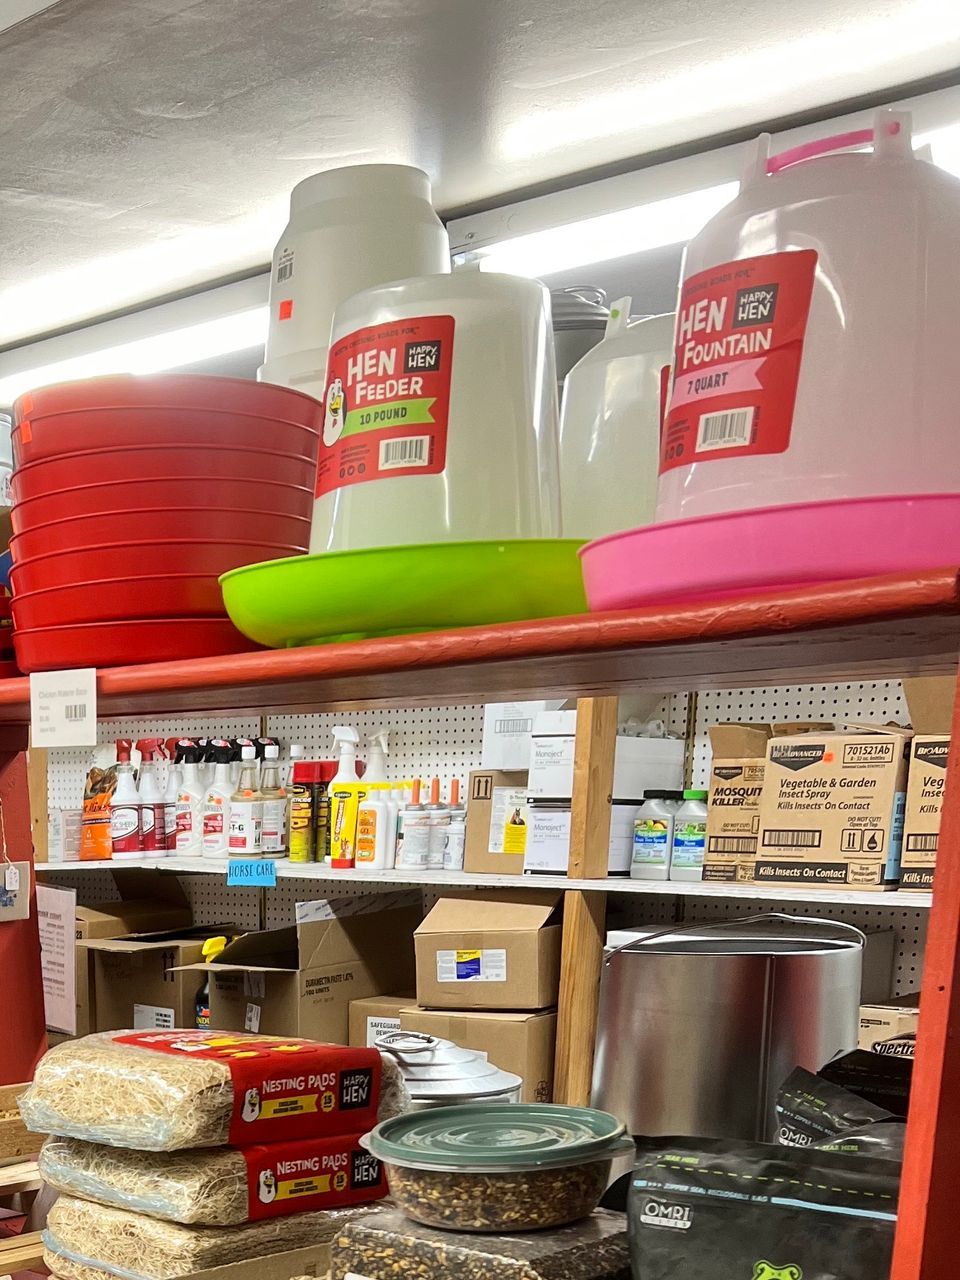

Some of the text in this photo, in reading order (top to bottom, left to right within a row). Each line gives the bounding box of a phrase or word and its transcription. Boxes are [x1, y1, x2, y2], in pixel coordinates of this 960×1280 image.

[740, 291, 773, 305] HAPPY
[738, 303, 770, 320] HEN
[678, 297, 727, 345] HEN
[409, 346, 437, 356] HAPPY
[683, 328, 772, 369] FOUNTAIN
[347, 348, 396, 386] HEN
[408, 354, 436, 368] HEN
[356, 376, 424, 404] FEEDER
[688, 372, 728, 394] 7 QUART
[359, 407, 407, 425] 10 POUND
[847, 746, 890, 755] 701521Ab
[780, 778, 877, 789] Vegetable & Garden
[712, 798, 745, 807] KILLER
[778, 790, 831, 800] Insect Spray
[777, 802, 794, 810] Kills
[824, 802, 836, 810] On
[837, 802, 870, 810] Contact
[920, 805, 938, 814] Kills
[229, 862, 274, 878] HORSE CARE
[759, 867, 774, 876] Kills
[775, 867, 801, 877] Insects
[803, 868, 814, 877] On
[816, 868, 846, 878] Contact
[903, 873, 920, 882] Kills
[262, 1073, 336, 1095] NESTING PADS
[343, 1075, 369, 1089] HAPPY
[343, 1084, 368, 1104] HEN
[779, 1128, 812, 1146] OMRI
[277, 1153, 348, 1175] NESTING PADS
[354, 1164, 379, 1183] HEN
[644, 1202, 690, 1221] OMRI
